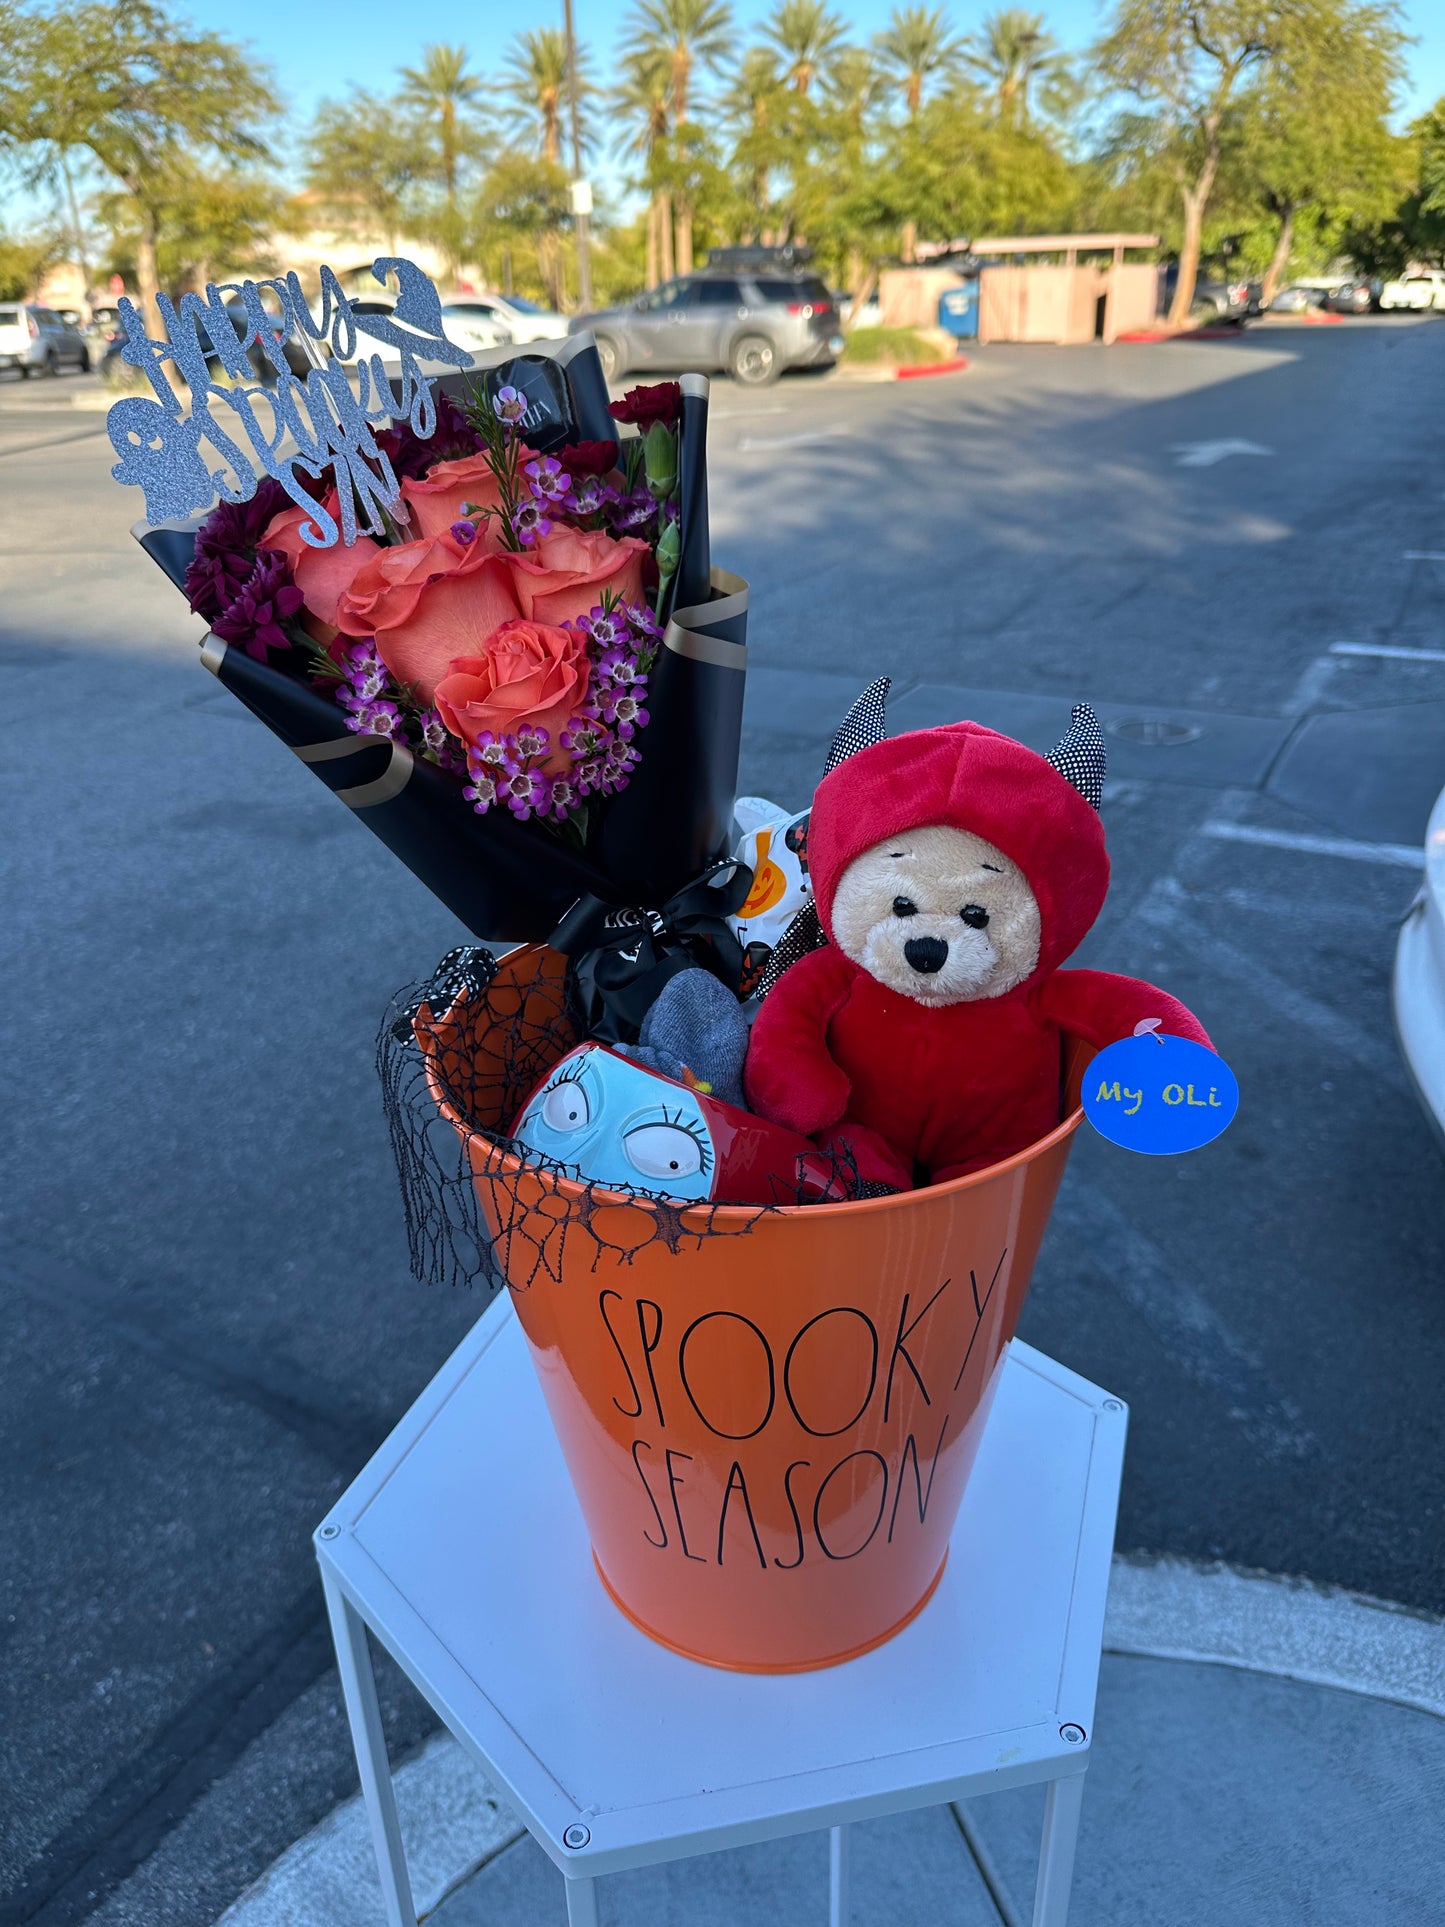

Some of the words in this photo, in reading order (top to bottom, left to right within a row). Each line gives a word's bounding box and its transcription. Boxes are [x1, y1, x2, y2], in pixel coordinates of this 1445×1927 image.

[1095, 1080, 1143, 1116] My
[599, 1247, 1008, 1441] SPOOKY
[631, 1413, 950, 1569] SEASON
